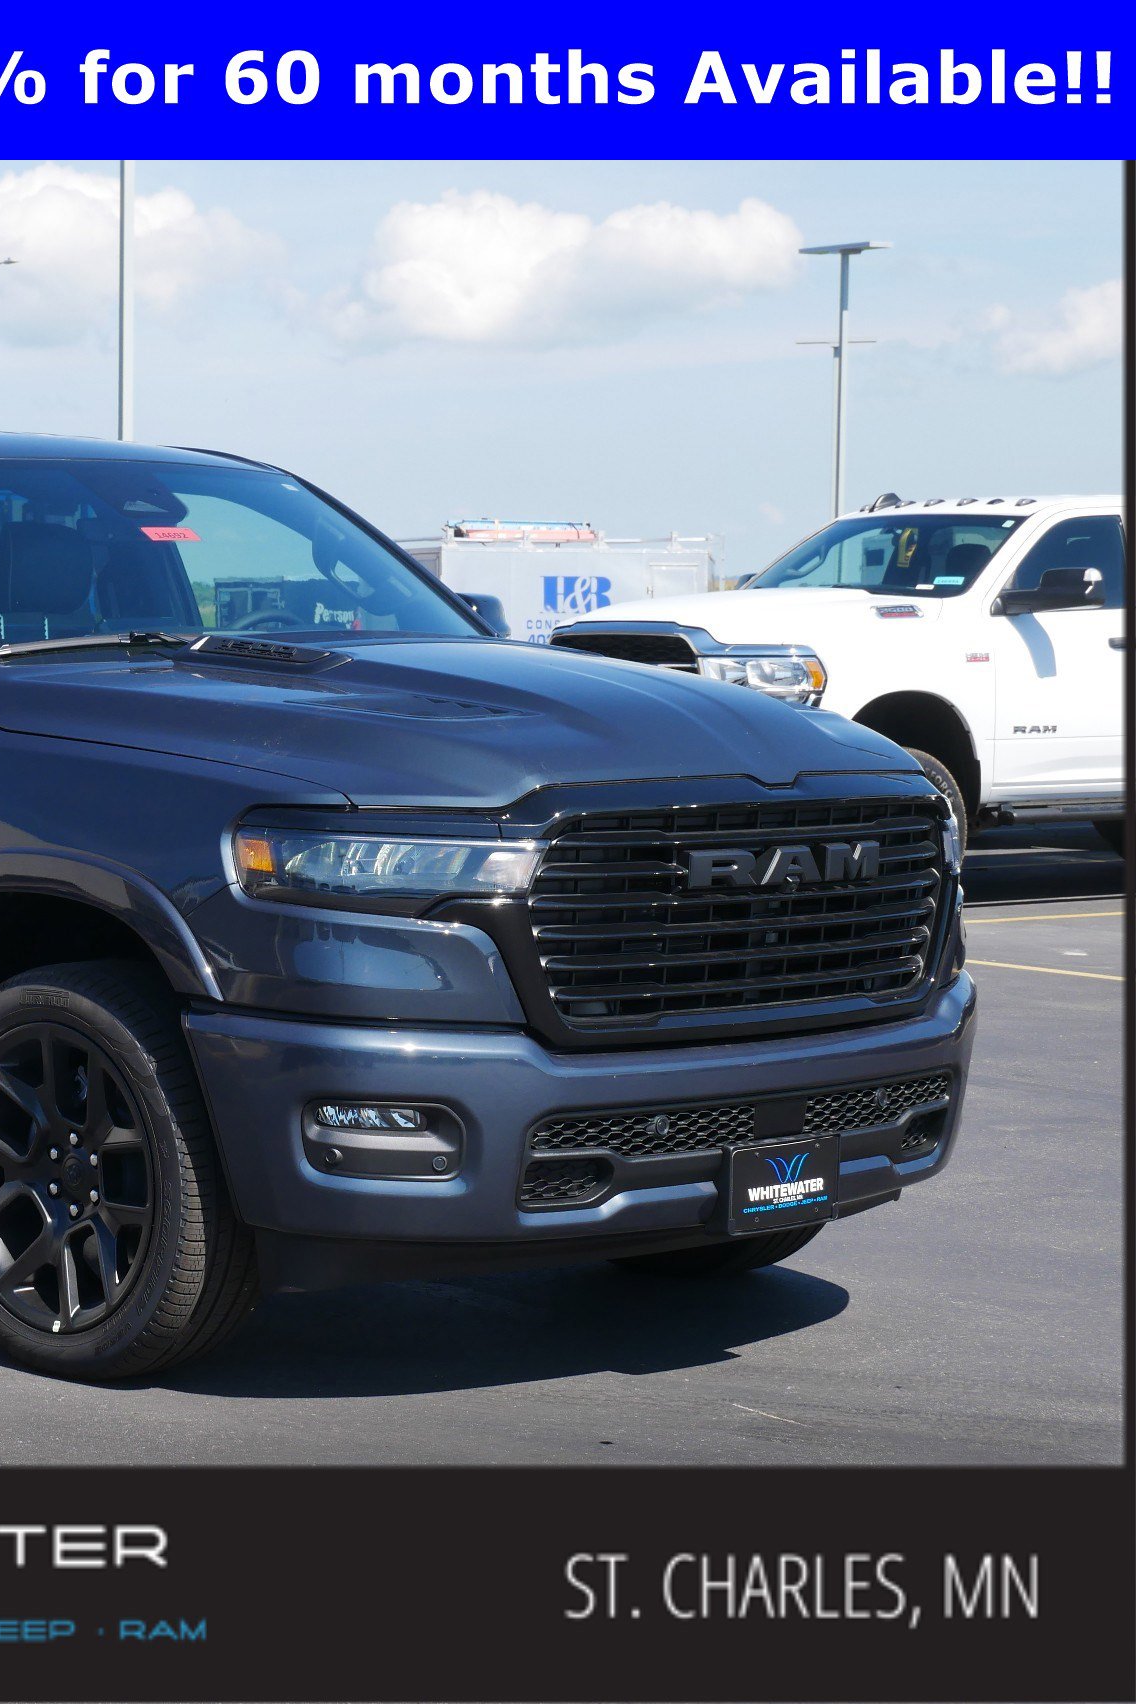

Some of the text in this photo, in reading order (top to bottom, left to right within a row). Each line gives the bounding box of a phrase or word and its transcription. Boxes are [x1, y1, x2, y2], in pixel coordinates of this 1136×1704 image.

[1012, 725, 1058, 735] RAM
[688, 840, 880, 889] RAM
[747, 1177, 824, 1202] WHITEWATER
[743, 1202, 775, 1213] CHRYSLER
[778, 1200, 798, 1209] DODGE
